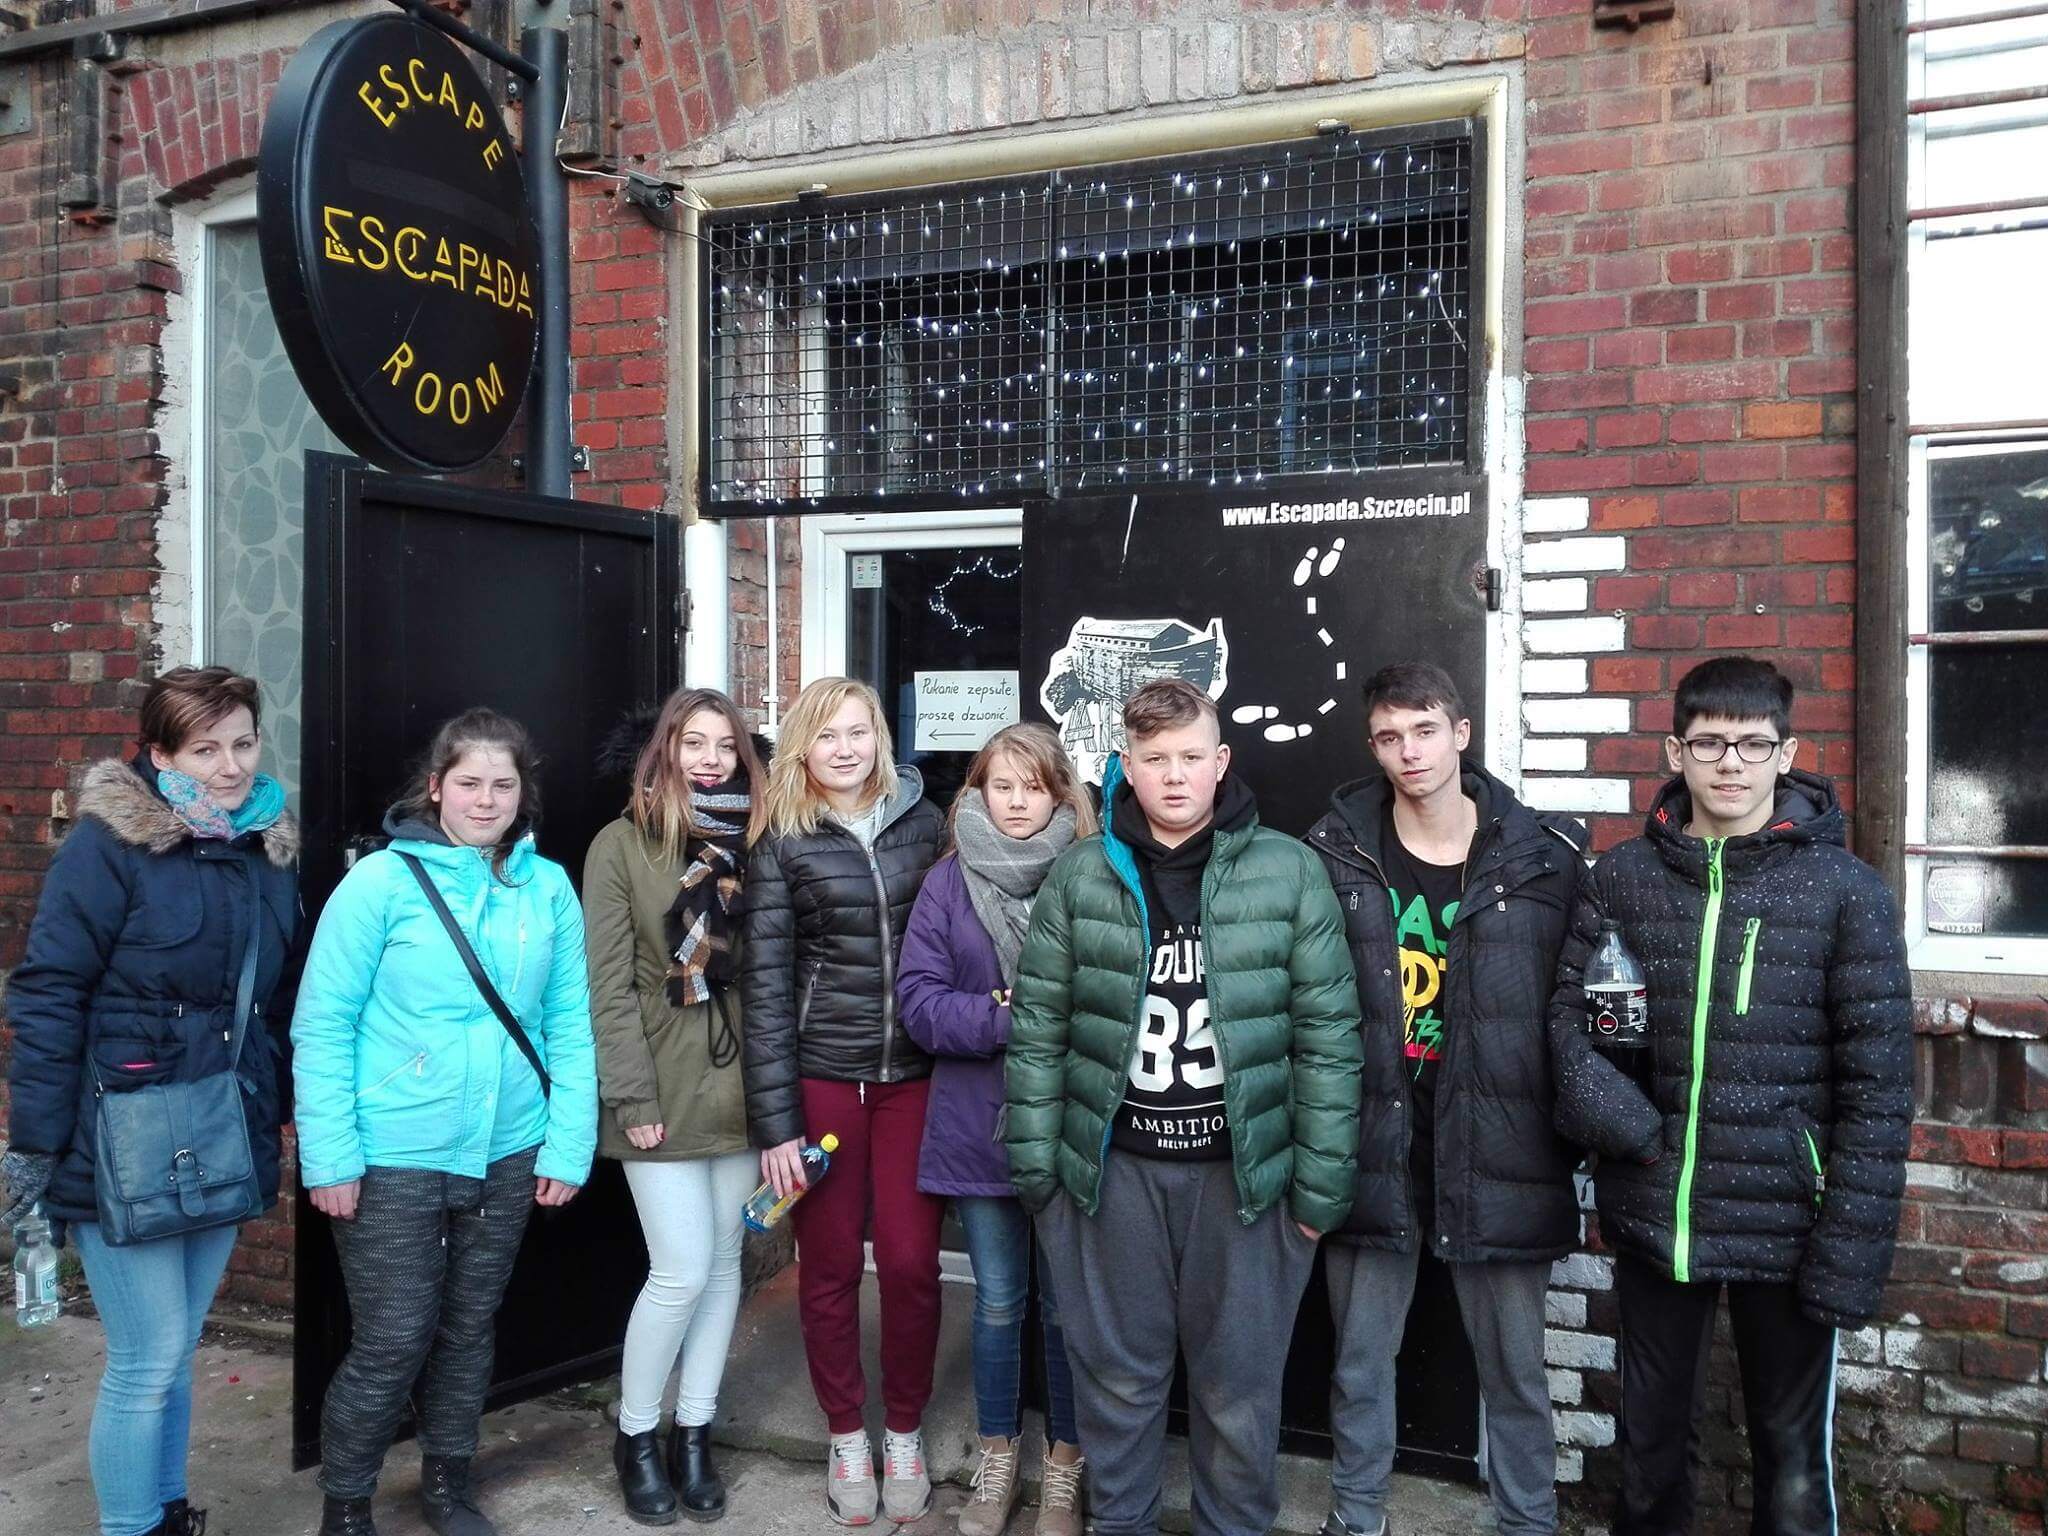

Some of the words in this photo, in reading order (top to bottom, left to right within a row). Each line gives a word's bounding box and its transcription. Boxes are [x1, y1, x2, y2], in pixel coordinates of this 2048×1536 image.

[357, 57, 504, 171] ESCAPE
[323, 205, 534, 319] ESCAPADA
[382, 341, 505, 425] ROOM
[1222, 491, 1471, 527] www.Escapada.Szczecin.pl
[921, 677, 960, 695] Pukanie
[1132, 1114, 1230, 1136] AMBITIO
